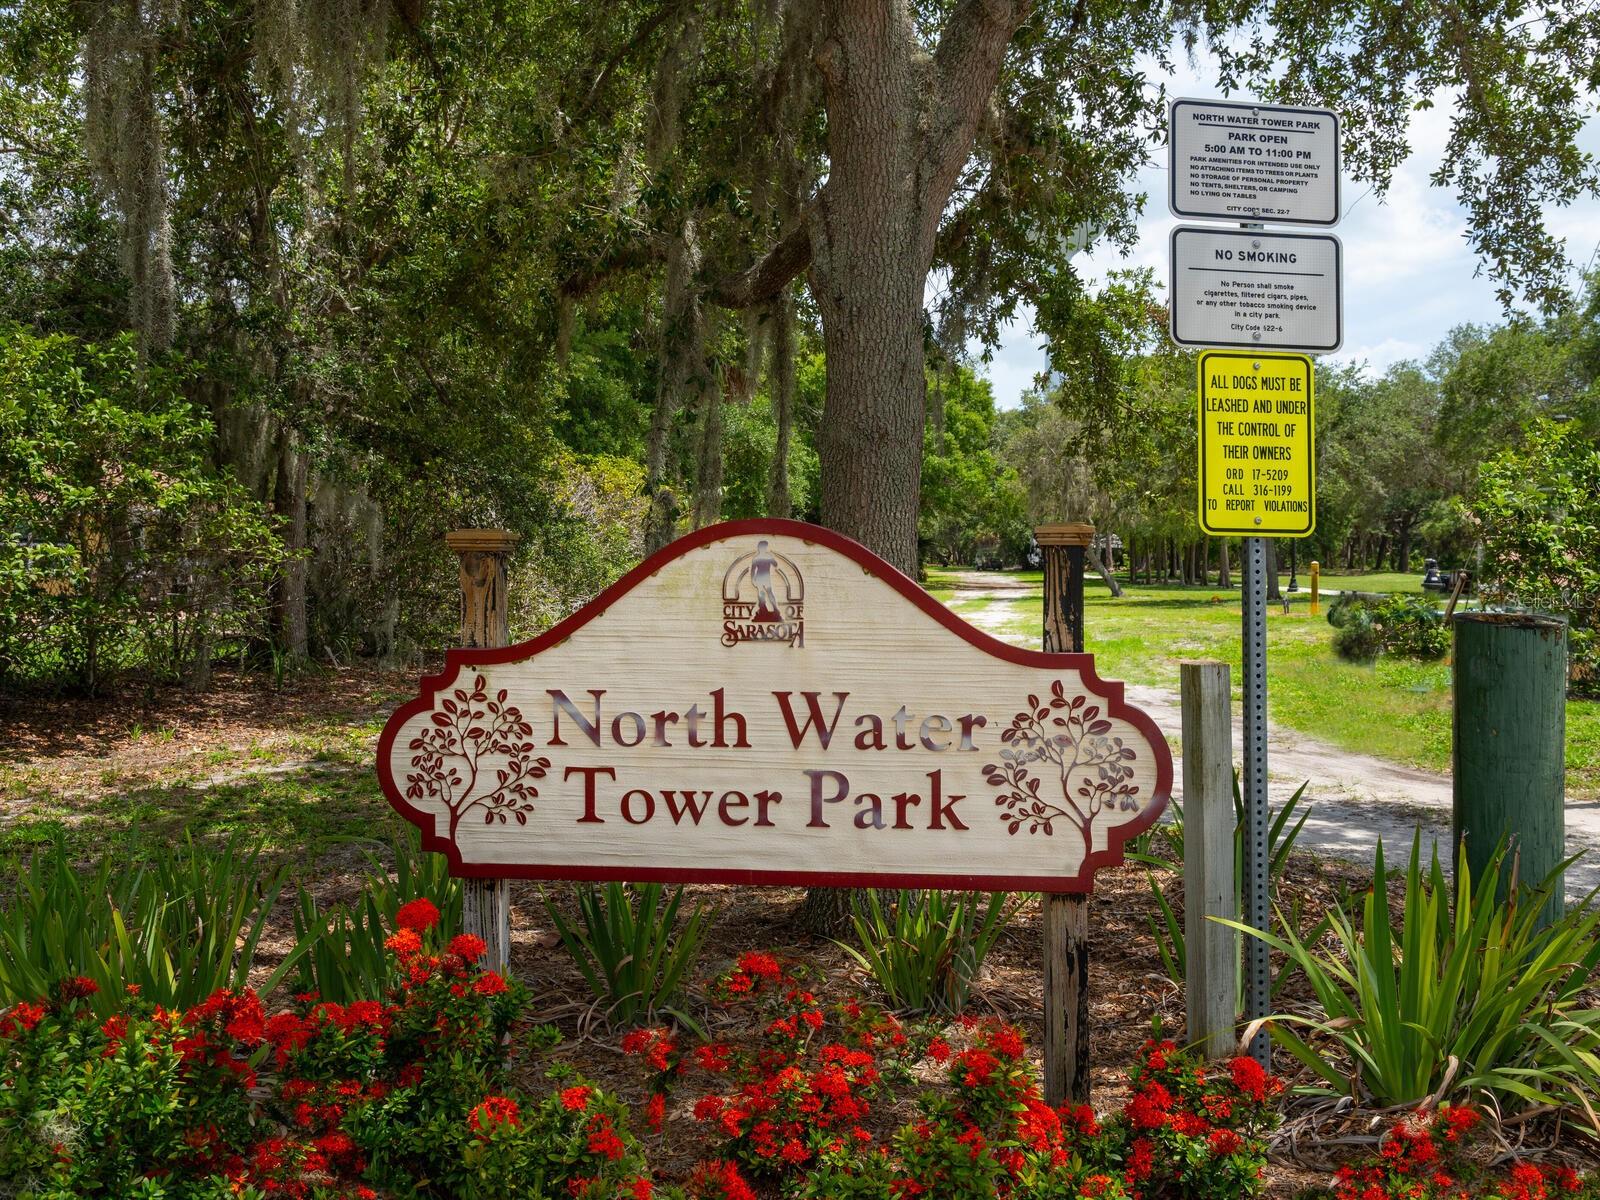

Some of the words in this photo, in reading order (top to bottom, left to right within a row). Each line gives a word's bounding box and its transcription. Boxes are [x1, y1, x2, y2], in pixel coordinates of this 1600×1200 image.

[1193, 113, 1224, 122] NORTH
[1227, 116, 1258, 125] WATER
[1262, 119, 1293, 127] TOWER
[1296, 121, 1320, 129] PARK
[1229, 132, 1256, 142] PARK
[1260, 135, 1288, 144] OPEN
[1205, 144, 1226, 153] 5:00
[1229, 146, 1245, 154] AM
[1248, 147, 1262, 156] TO
[1266, 149, 1293, 157] 11:00
[1296, 151, 1311, 159] PM
[1209, 157, 1242, 165] AMENITIES
[1200, 165, 1235, 173] ATTACHING
[1242, 176, 1274, 184] PERSONAL
[1225, 184, 1257, 192] SHELTERS,
[1215, 250, 1233, 260] NO
[1238, 251, 1297, 263] SMOKING
[1232, 281, 1254, 289] Person
[1204, 290, 1239, 298] cigarettes,
[1241, 291, 1265, 299] filtered
[1268, 303, 1294, 311] smoking
[1231, 324, 1244, 332] City
[1211, 375, 1228, 389] ALL
[1233, 376, 1257, 390] DOGS
[1262, 377, 1286, 391] MUST
[1290, 378, 1301, 391] BE
[1207, 398, 1248, 412] LEASHED
[1253, 400, 1272, 413] AND
[1276, 401, 1306, 415] UNDER
[1217, 422, 1234, 436] THE
[1238, 422, 1280, 437] CONTROL
[1285, 424, 1296, 437] OF
[1223, 445, 1248, 459] THEIR
[1253, 446, 1291, 460] OWNERS
[1226, 469, 1243, 480] ORD
[1252, 469, 1288, 481] 17-5209
[1223, 484, 1244, 495] CALL
[1253, 485, 1292, 496] 316-1199
[1208, 499, 1217, 511] TO
[1226, 499, 1255, 511] REPORT
[1264, 501, 1307, 512] VIOLATIONS
[723, 606, 755, 616] CITY
[785, 606, 804, 618] OF
[546, 687, 752, 748] North
[772, 691, 987, 752] Water
[564, 766, 782, 827] Tower
[803, 768, 970, 831] Park
